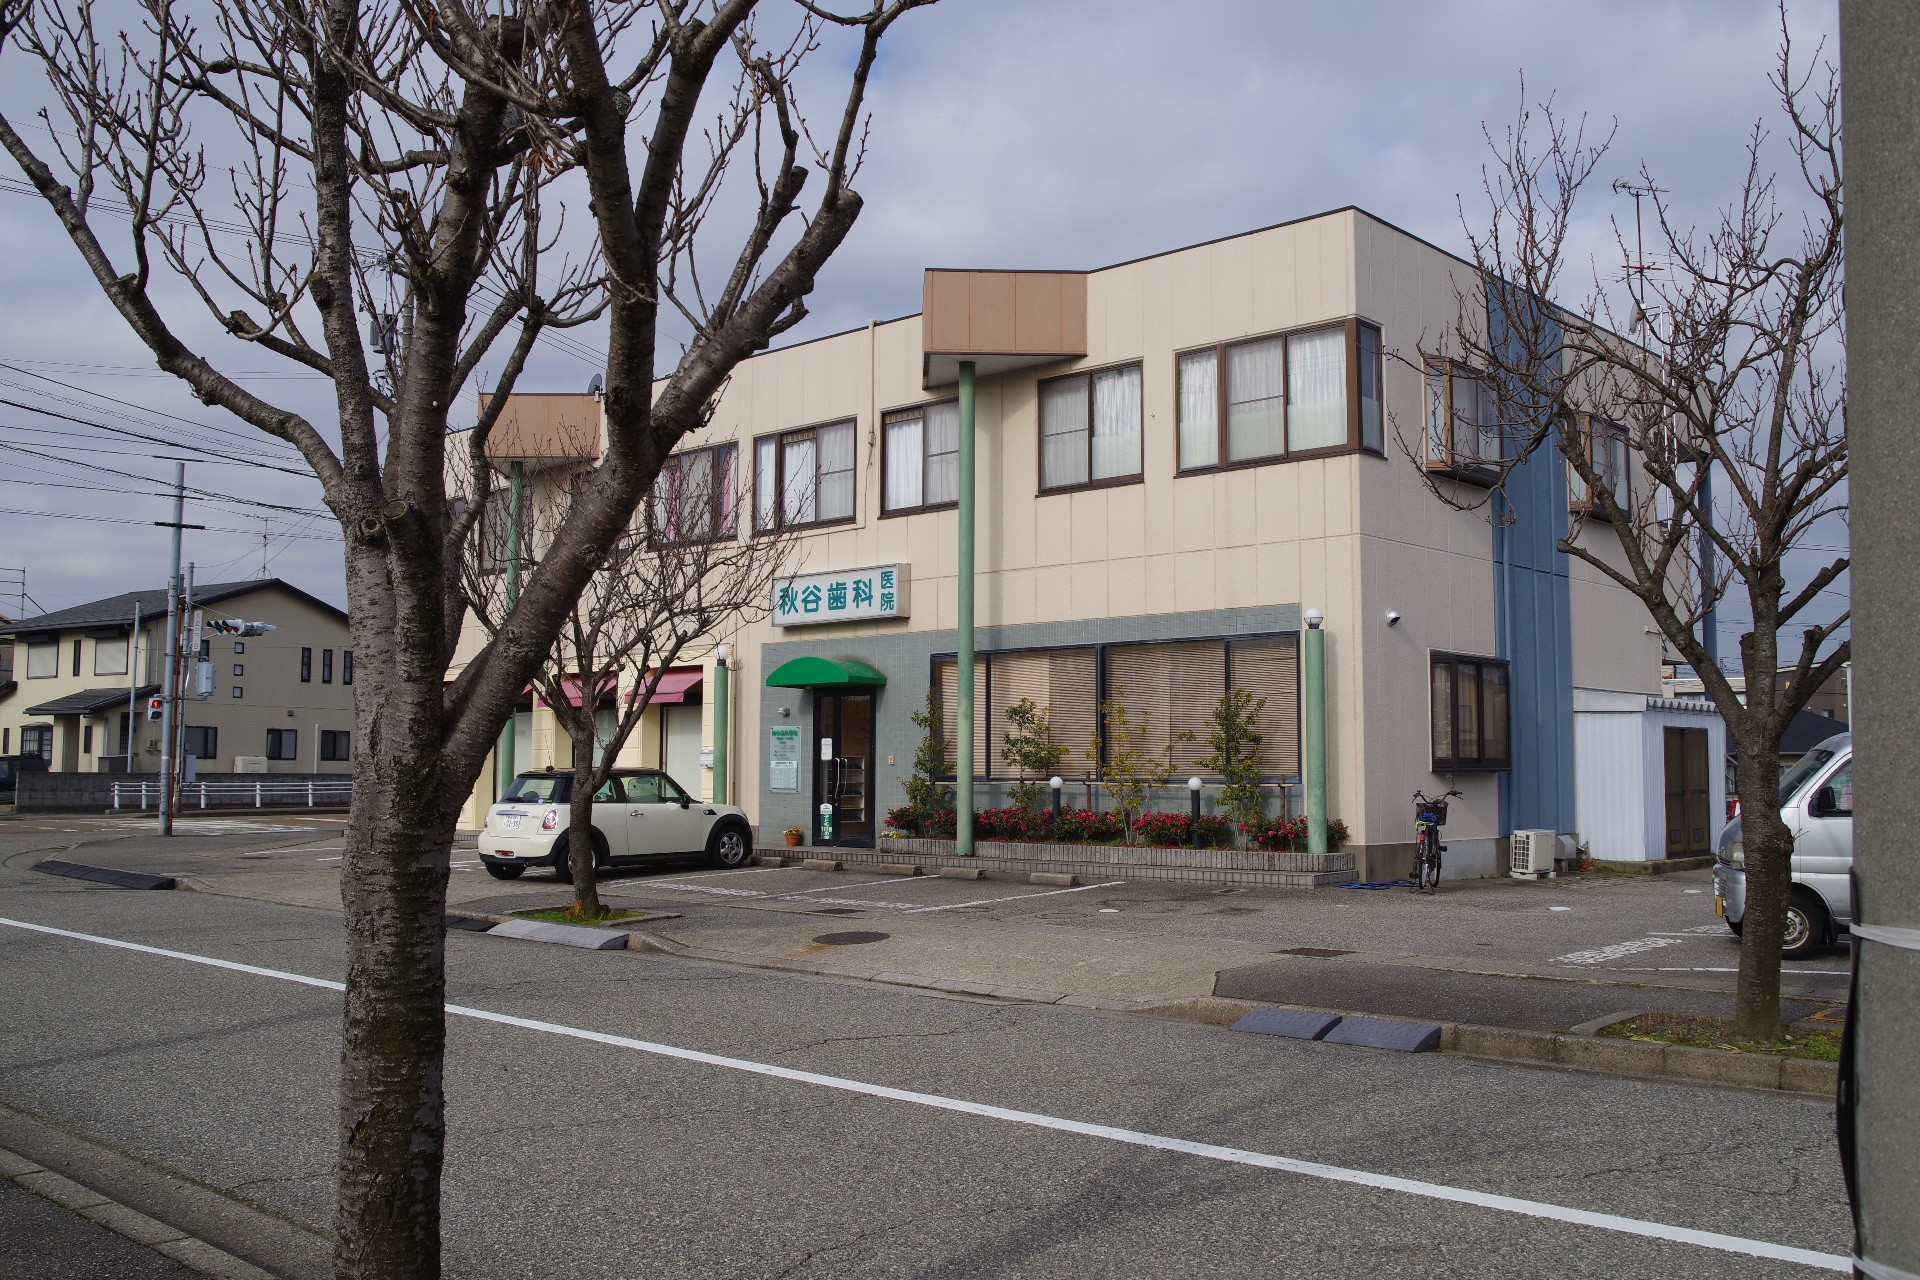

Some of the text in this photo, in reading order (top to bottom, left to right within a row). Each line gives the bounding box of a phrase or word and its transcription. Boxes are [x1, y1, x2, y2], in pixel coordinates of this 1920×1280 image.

[779, 578, 874, 616] 秋谷歯科
[880, 570, 895, 612] 医院
